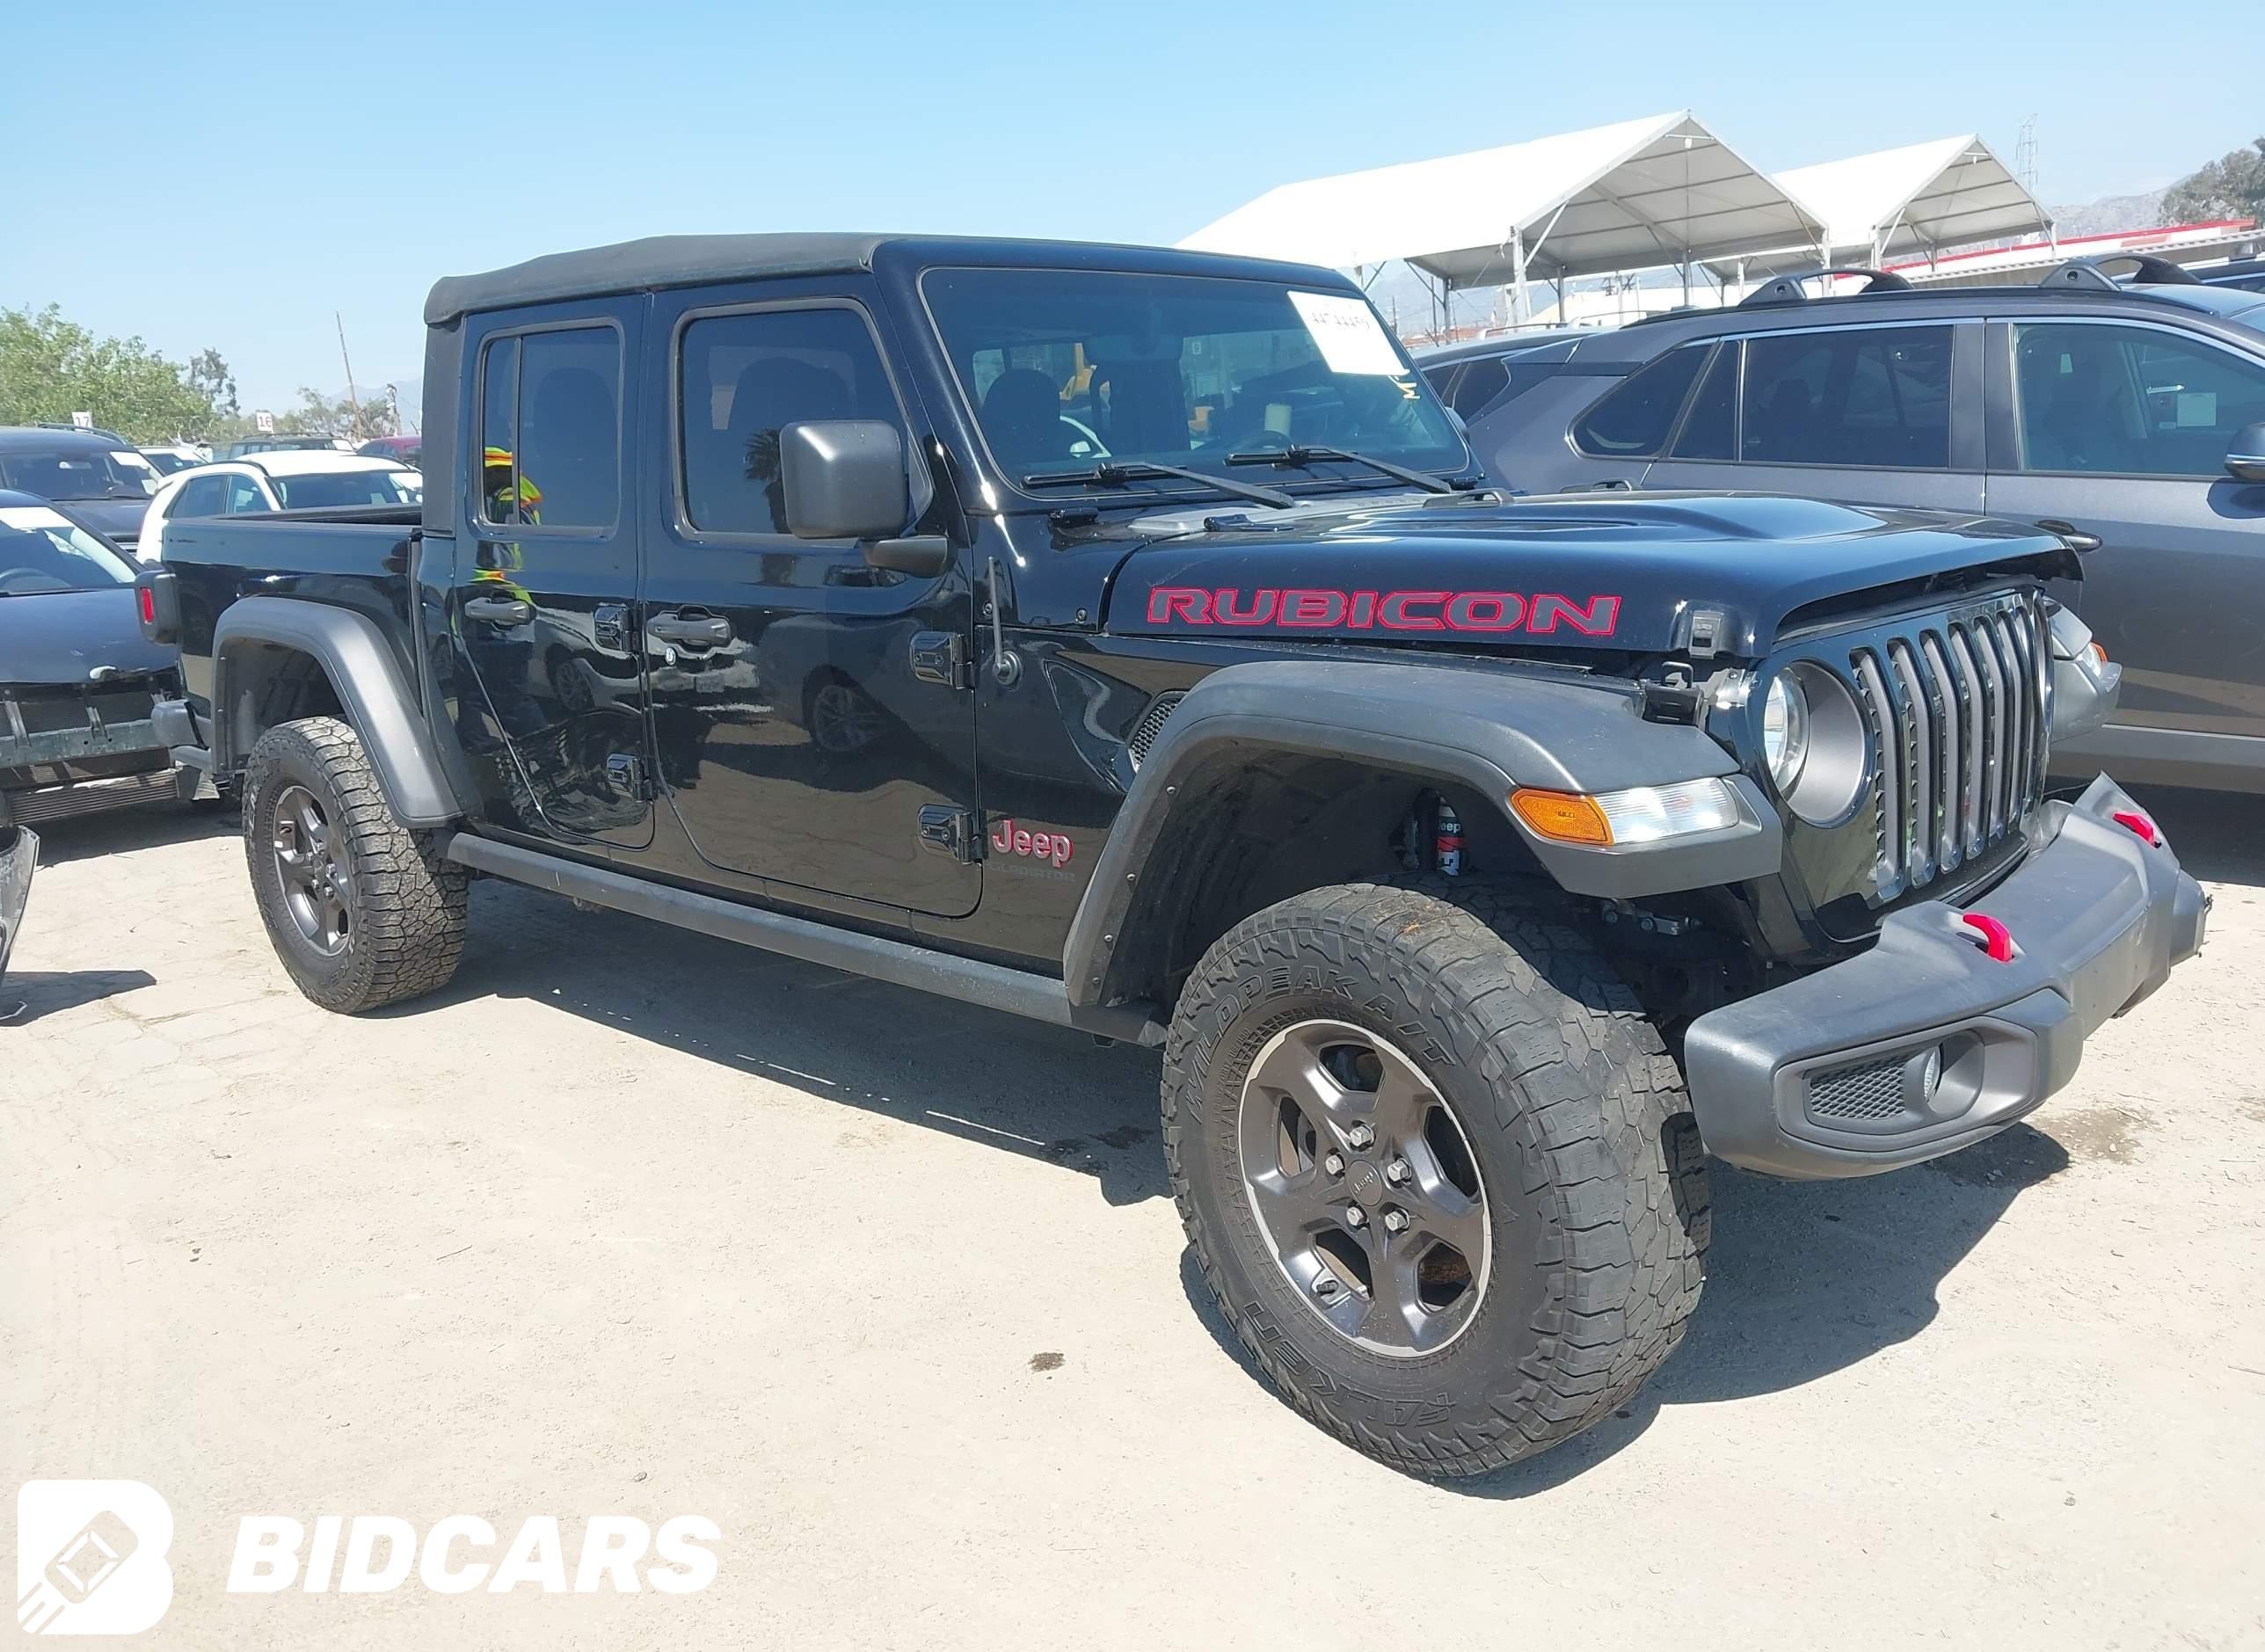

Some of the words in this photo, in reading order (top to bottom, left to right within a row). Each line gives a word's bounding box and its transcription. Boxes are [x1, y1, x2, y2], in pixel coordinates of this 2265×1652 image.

[75, 416, 90, 428] 17
[259, 416, 272, 427] 16
[1147, 587, 1622, 636] RUBICON
[992, 819, 1073, 869] Jeep
[1187, 965, 1359, 1124] WILDPEAK
[1243, 1301, 1456, 1428] FALKEN
